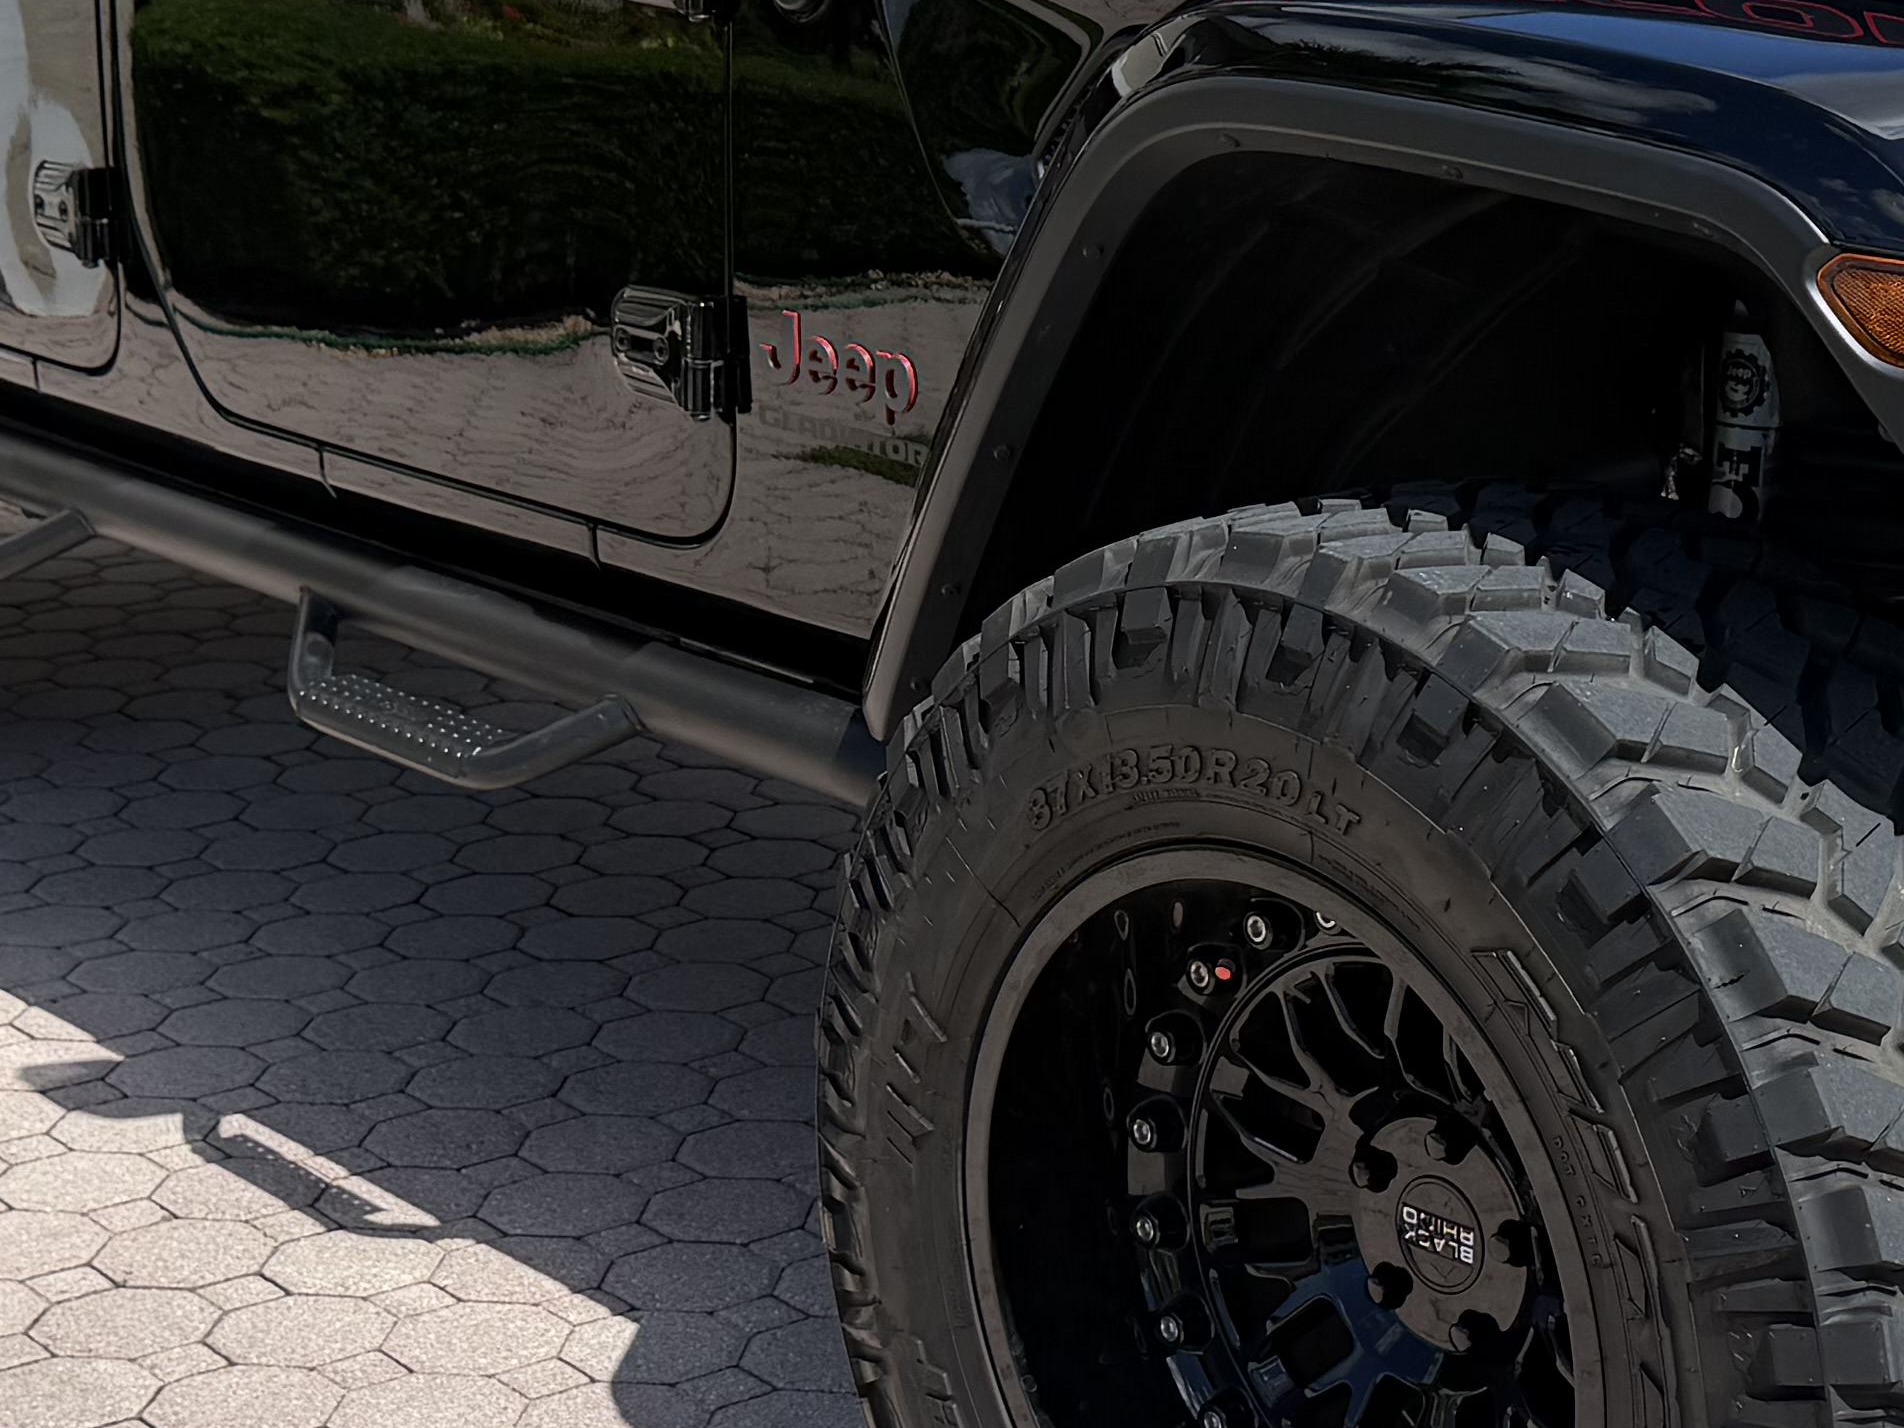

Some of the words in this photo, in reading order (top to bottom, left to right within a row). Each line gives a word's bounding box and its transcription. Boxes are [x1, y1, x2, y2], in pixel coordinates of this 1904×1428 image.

[759, 309, 919, 425] Jeep
[1402, 1206, 1475, 1246] RHINO
[1403, 1224, 1474, 1264] BLACK
